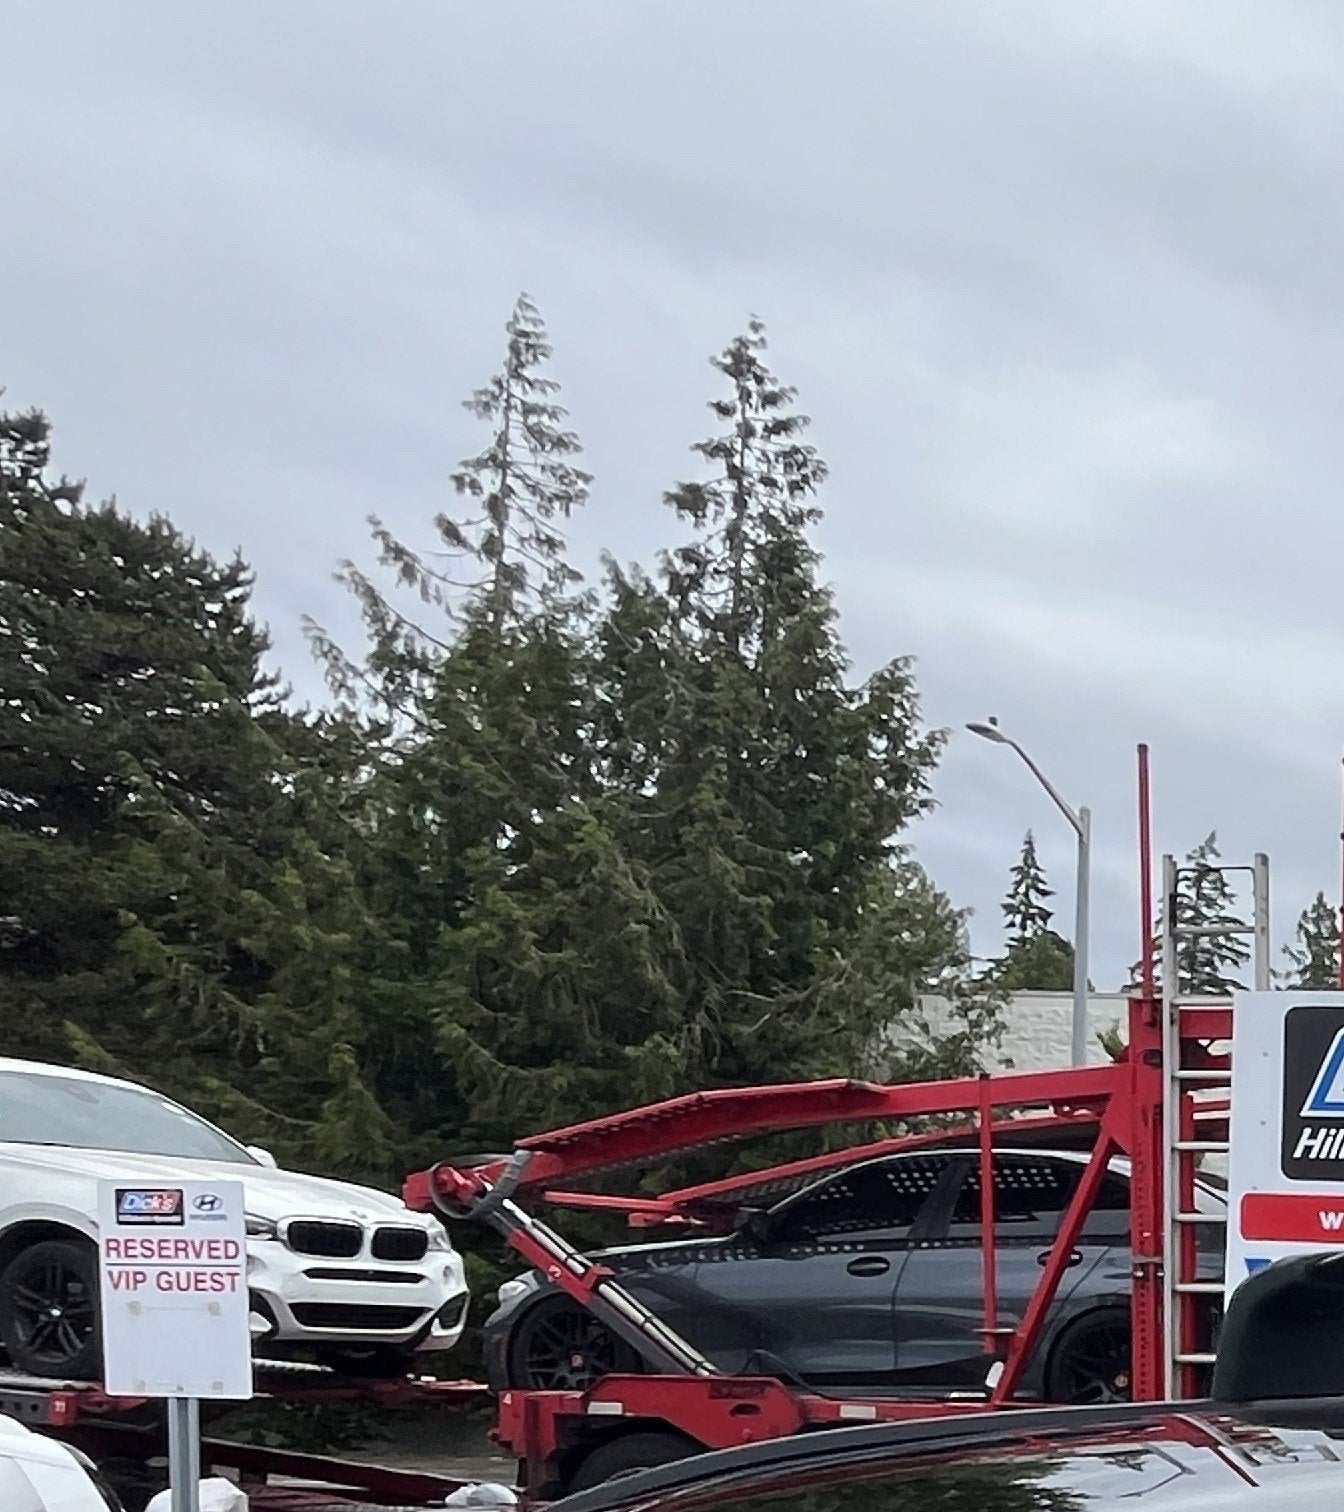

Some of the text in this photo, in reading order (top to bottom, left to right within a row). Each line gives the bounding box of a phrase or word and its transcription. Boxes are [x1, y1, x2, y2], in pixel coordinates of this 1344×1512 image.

[105, 1238, 240, 1260] RESERVED
[107, 1270, 241, 1292] VIP GUEST
